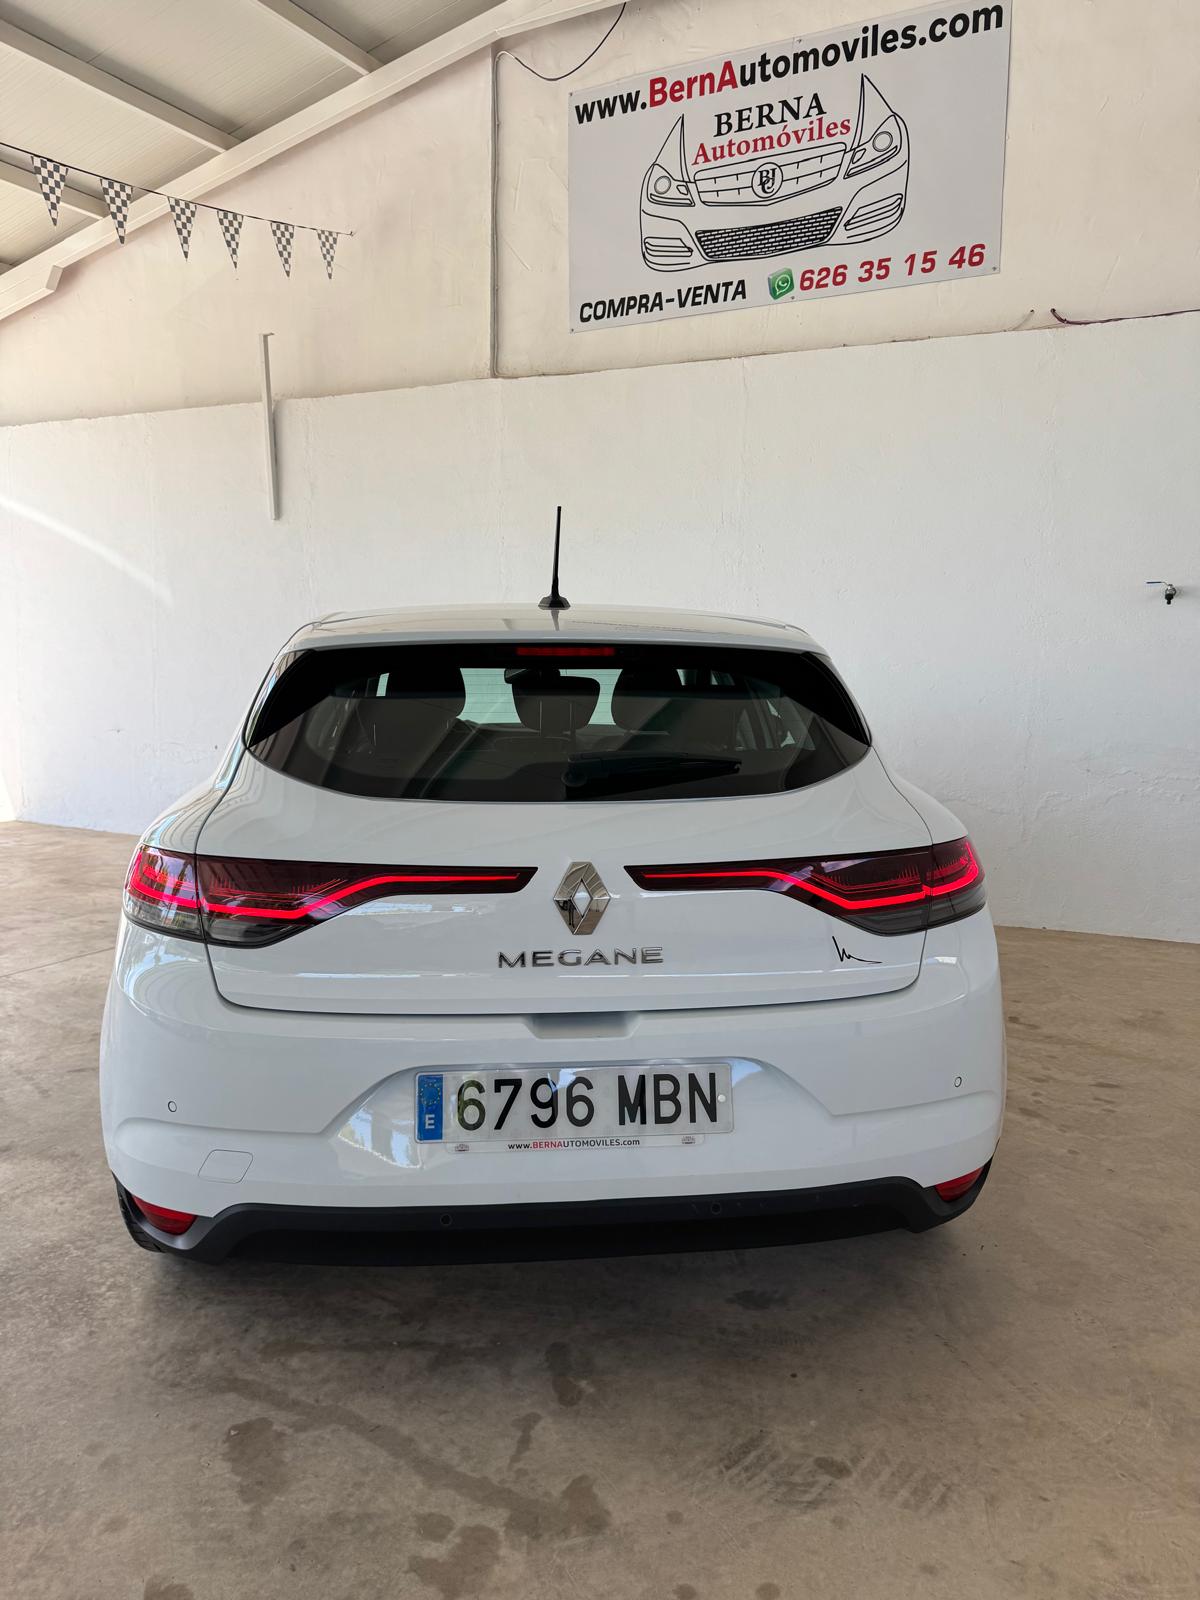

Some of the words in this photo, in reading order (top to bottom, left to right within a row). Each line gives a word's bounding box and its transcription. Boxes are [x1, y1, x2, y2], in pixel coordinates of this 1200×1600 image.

[575, 3, 1004, 125] www.BernAutomoviles.com
[714, 92, 827, 138] BERNA
[691, 116, 852, 166] Automóviles
[799, 263, 848, 292] 626
[857, 256, 891, 284] 35
[904, 249, 937, 277] 15
[948, 243, 986, 269] 46
[579, 279, 747, 323] COMPRA-VENTA
[497, 946, 664, 969] MEGANE
[424, 1113, 435, 1130] E
[456, 1075, 595, 1132] 6796
[617, 1072, 718, 1127] MBN
[507, 1138, 641, 1150] www.BERNAUTOMOVILES.com
